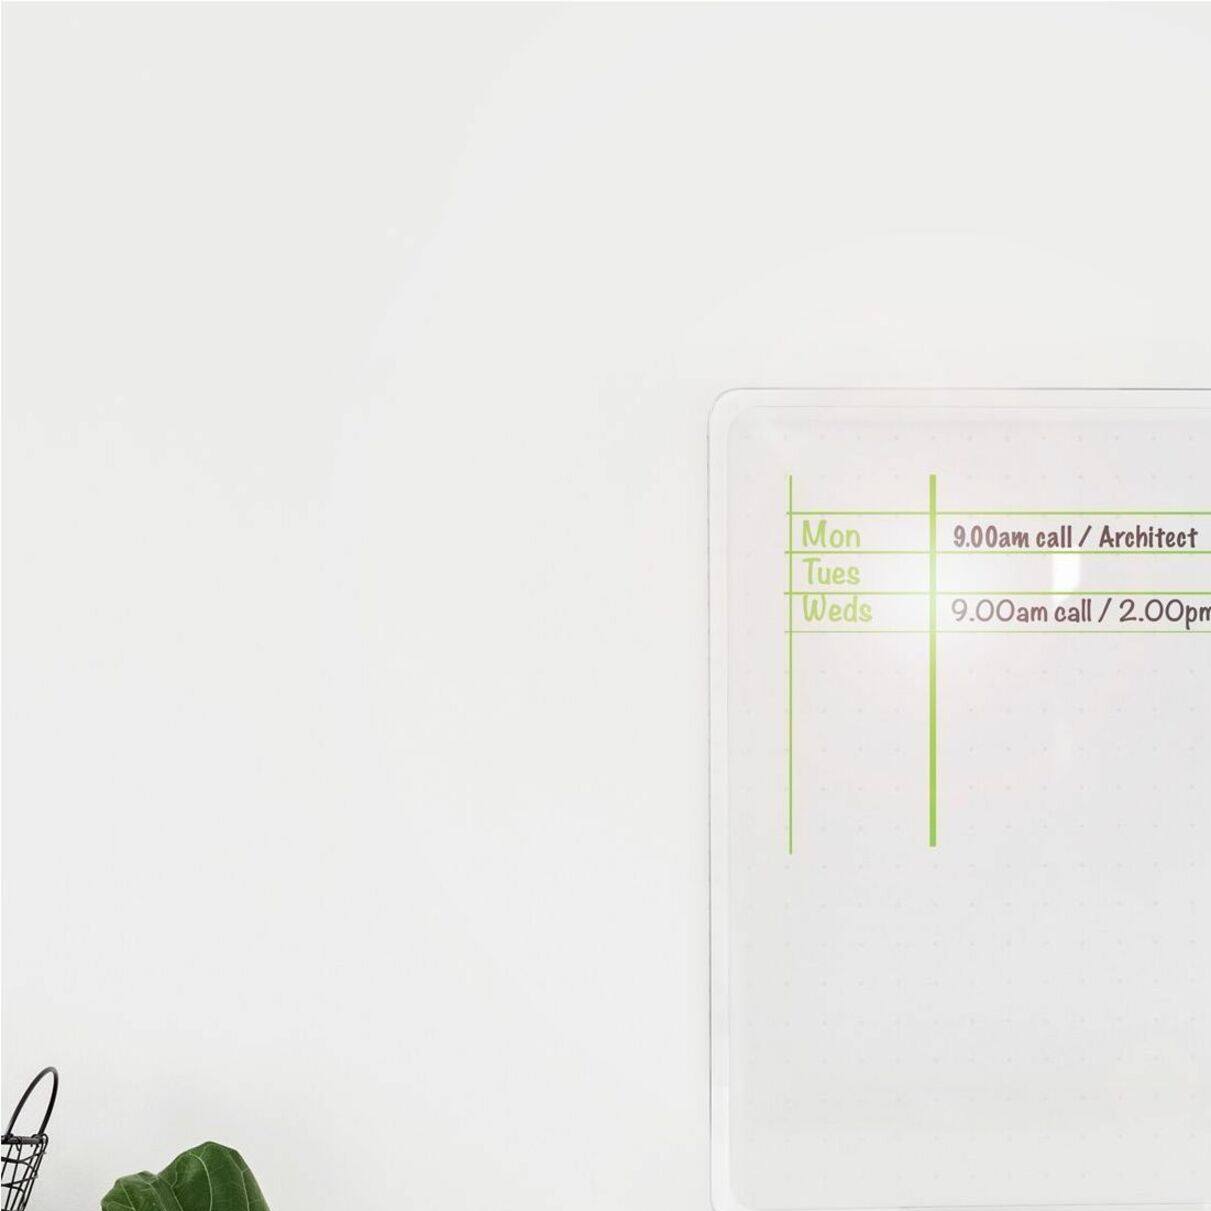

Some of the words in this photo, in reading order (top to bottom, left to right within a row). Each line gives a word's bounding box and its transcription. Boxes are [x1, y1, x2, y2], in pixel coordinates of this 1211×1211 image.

[802, 519, 861, 548] Mon
[953, 526, 1029, 548] 9.00am
[1035, 525, 1072, 548] call
[1078, 525, 1093, 548] /
[1099, 525, 1198, 548] Architect
[802, 557, 861, 585] Tues
[802, 594, 873, 622] Weds
[951, 600, 1048, 623] 9.00am
[1054, 599, 1092, 623] call
[1097, 599, 1112, 623] /
